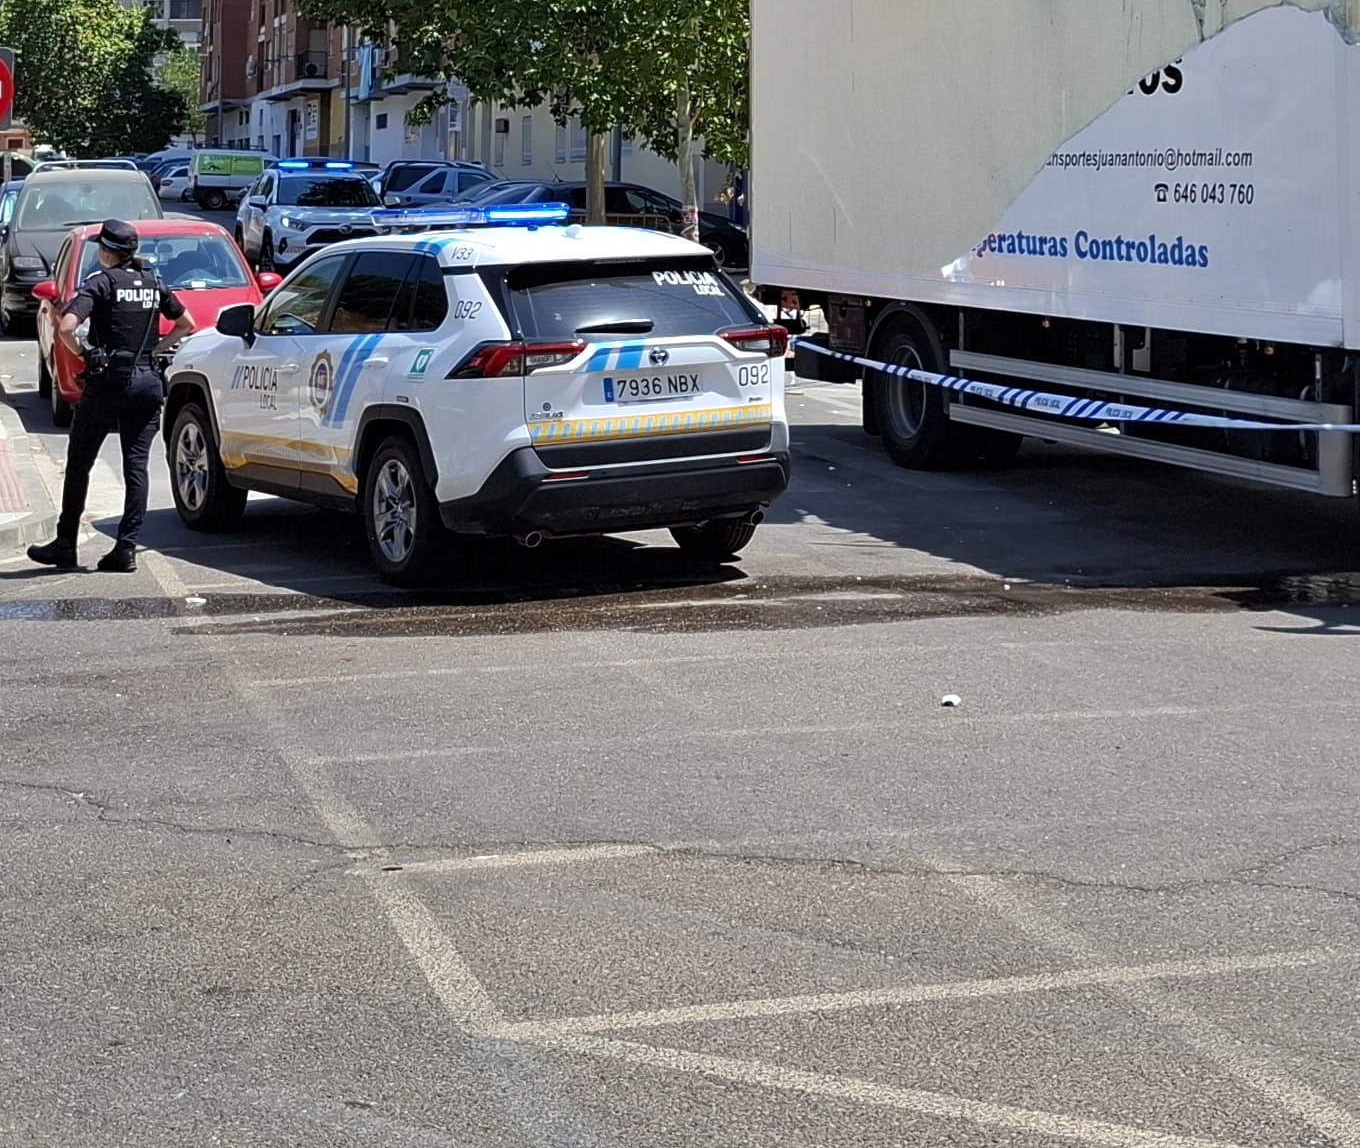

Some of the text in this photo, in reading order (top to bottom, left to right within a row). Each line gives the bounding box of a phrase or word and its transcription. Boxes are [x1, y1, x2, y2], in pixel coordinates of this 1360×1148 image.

[1046, 148, 1253, 171] ansportesjuanantonio@hotmail.com
[1173, 182, 1254, 205] 646 043 760
[451, 246, 474, 260] V33
[972, 229, 1209, 268] peraturas Controladas
[651, 270, 718, 286] POLICIA
[116, 288, 160, 302] POLICIA
[454, 300, 482, 319] 092
[243, 365, 278, 392] POLICIA
[616, 373, 700, 398] 7936 NBX
[738, 364, 769, 387] 092
[260, 394, 277, 411] LOCAL
